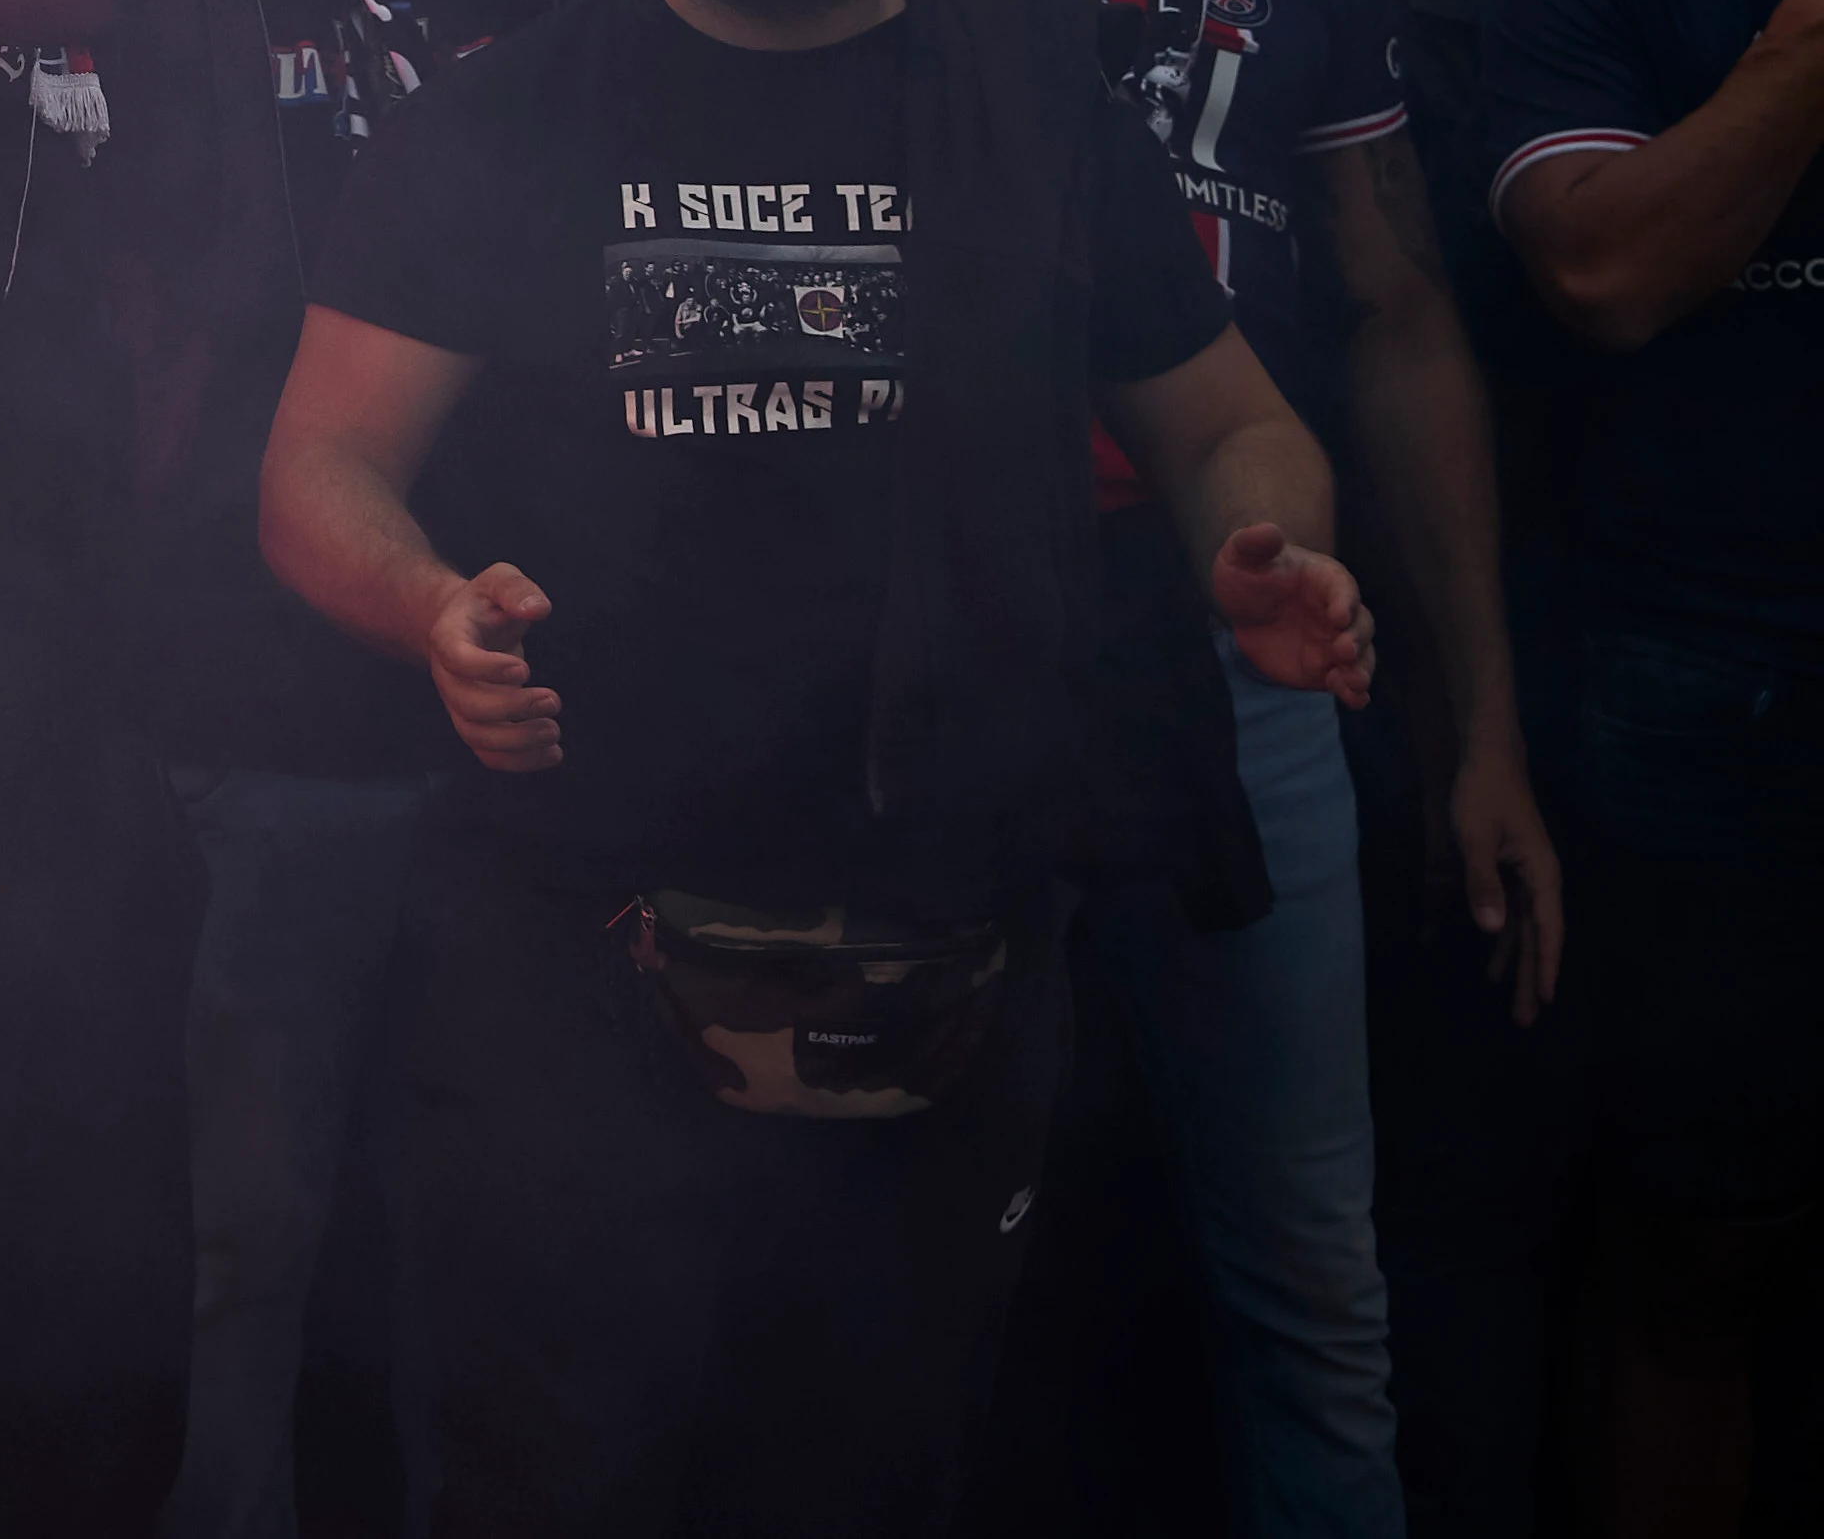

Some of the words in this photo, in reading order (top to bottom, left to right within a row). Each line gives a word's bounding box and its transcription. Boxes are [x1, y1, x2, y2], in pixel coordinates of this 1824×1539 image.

[620, 182, 657, 230] K
[677, 182, 815, 233] SOCE
[835, 183, 914, 233] TE
[623, 380, 835, 438] ULTRAS
[807, 1030, 879, 1047] EASTPAK
